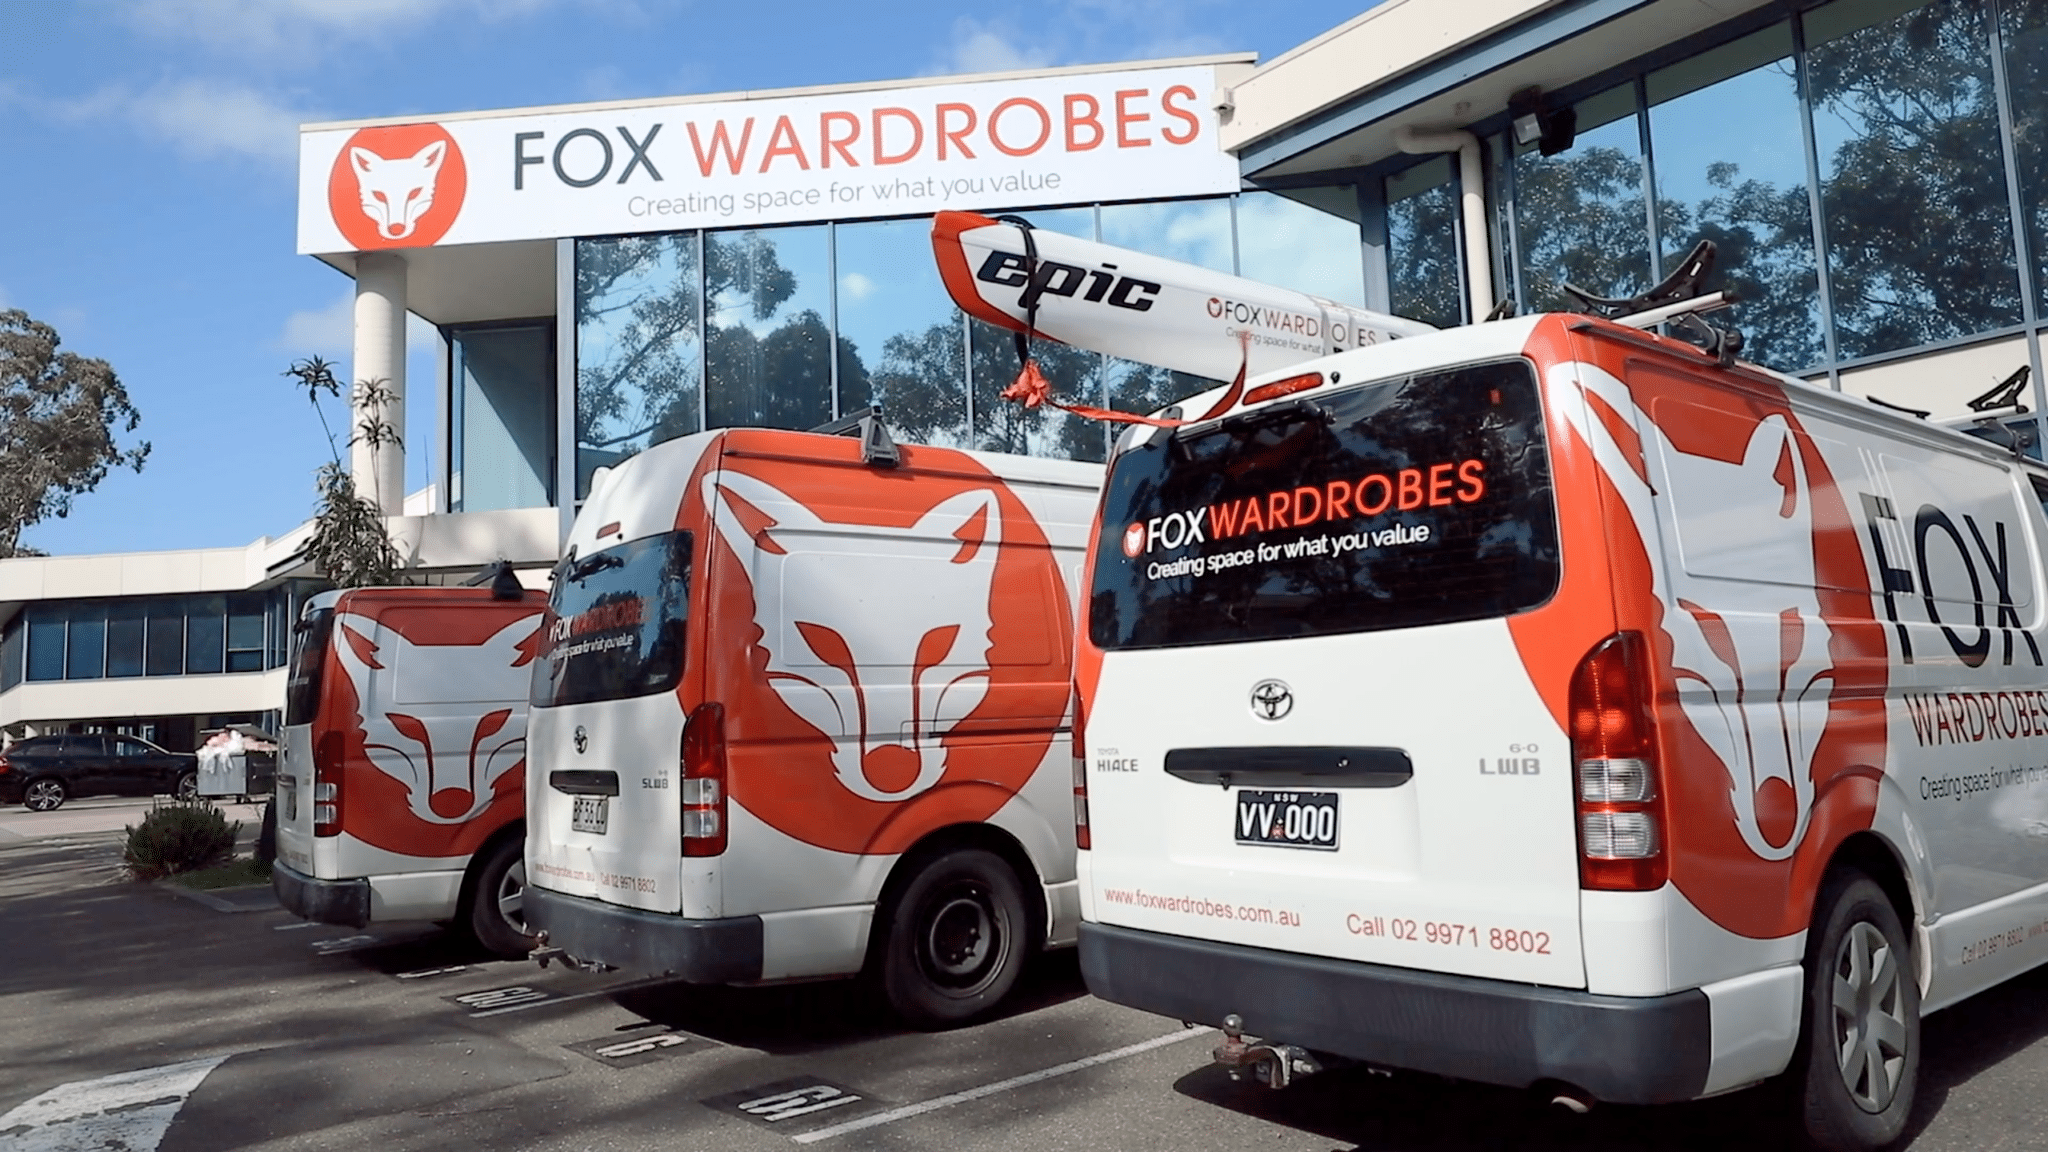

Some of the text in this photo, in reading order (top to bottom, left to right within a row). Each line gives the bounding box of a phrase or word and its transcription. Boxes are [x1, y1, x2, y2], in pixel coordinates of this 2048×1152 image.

[514, 84, 1200, 190] FOX WARDROBES
[628, 169, 1062, 217] Creating space for what you value
[976, 249, 1162, 313] epic
[1224, 300, 1261, 327] FOX
[1146, 459, 1485, 554] FOX WARDROBES
[1146, 522, 1430, 581] Creating space for what you value
[1859, 491, 2044, 669] FOX
[553, 614, 574, 642] FOX
[642, 777, 669, 789] SLWB
[1097, 758, 1139, 772] HIACE
[1479, 757, 1541, 776] LWB
[1273, 792, 1300, 803] NSW
[1920, 772, 1962, 802] Creating
[1962, 772, 1990, 800] space
[1240, 801, 1336, 843] VV 000
[619, 874, 636, 891] 9971
[637, 877, 656, 894] 8802
[1104, 888, 1302, 928] www.foxwardrobes.com.au
[1346, 913, 1551, 955] Call 02 9971 8802
